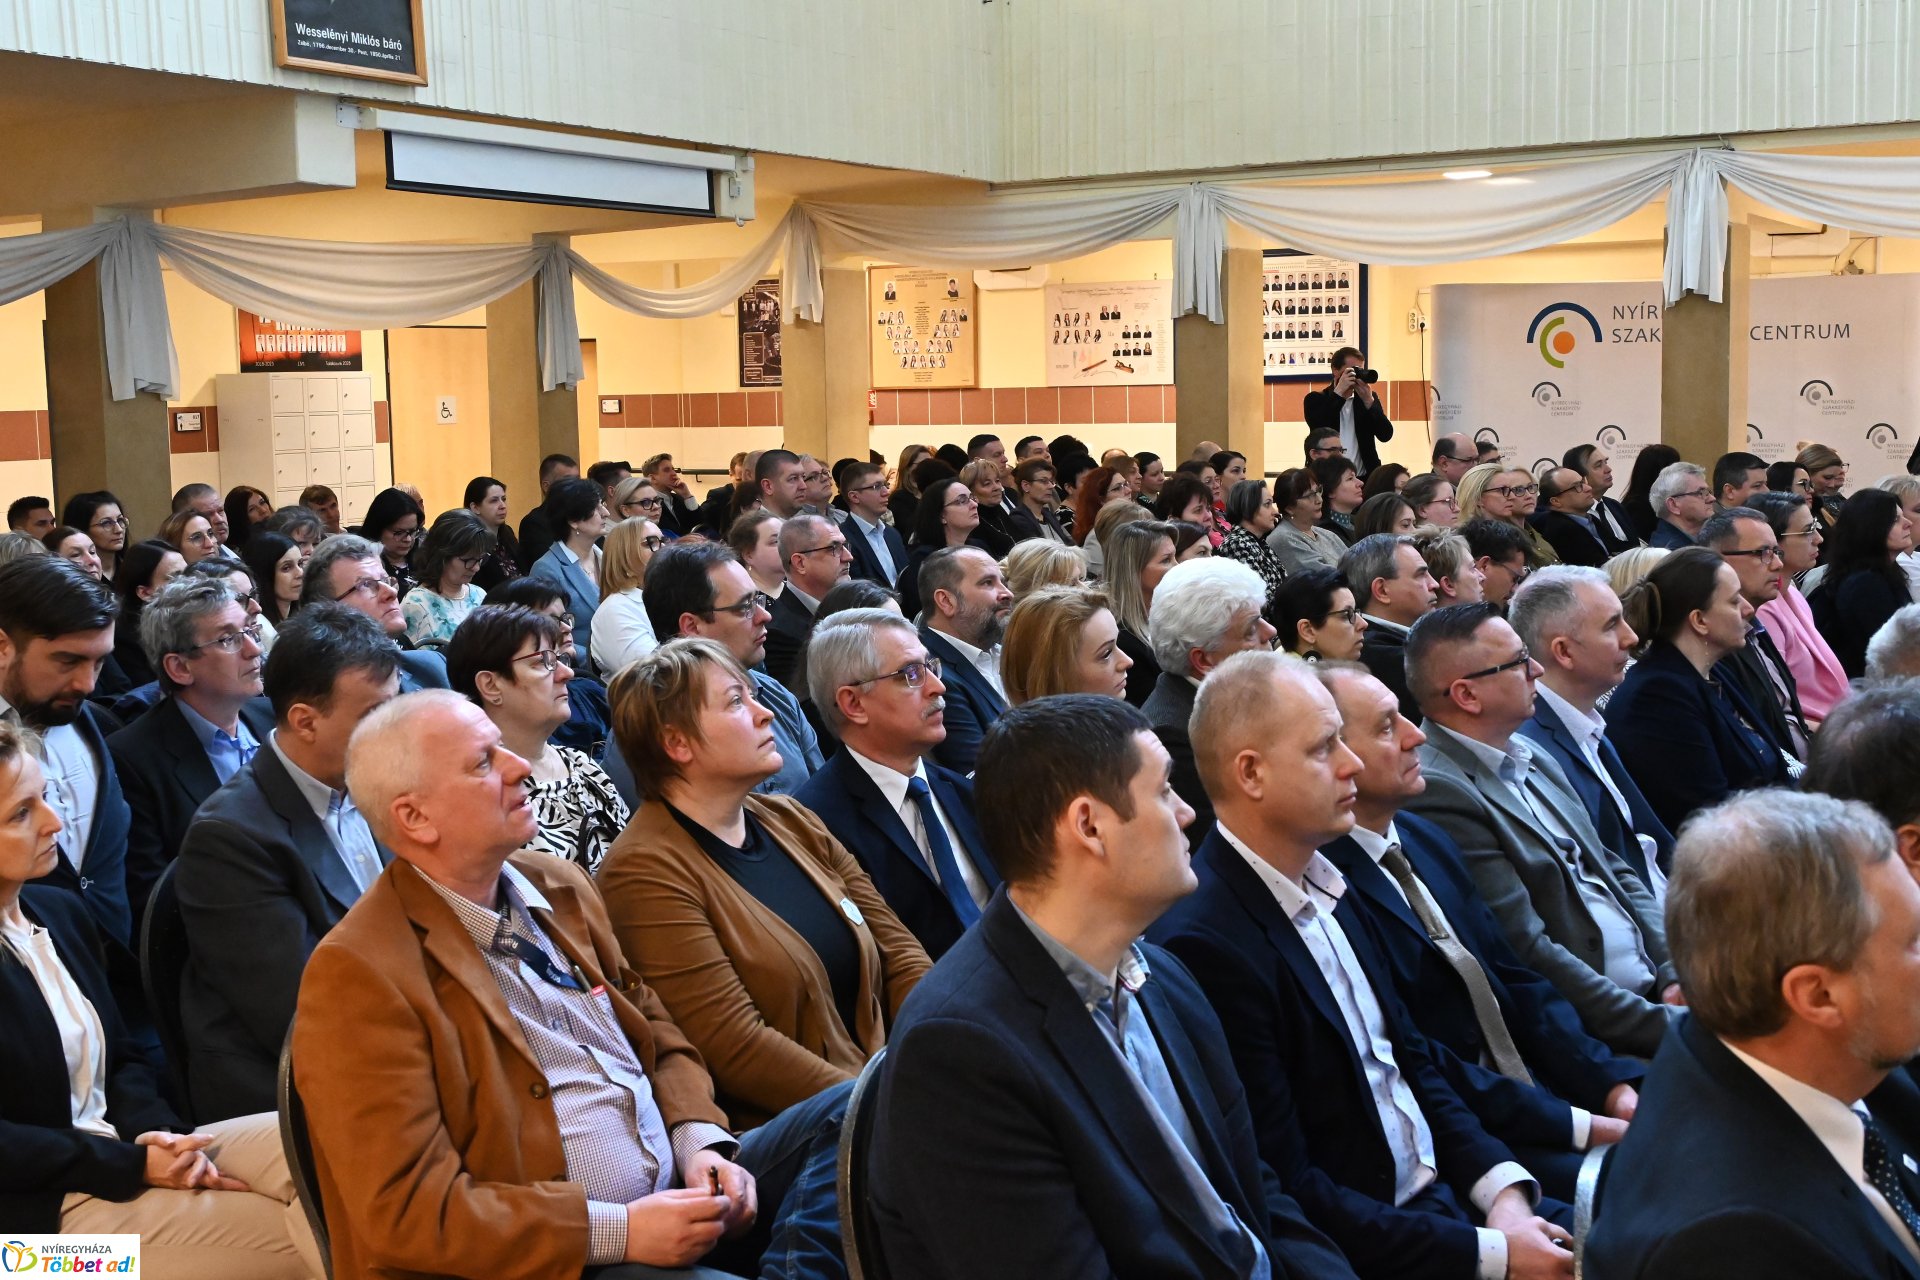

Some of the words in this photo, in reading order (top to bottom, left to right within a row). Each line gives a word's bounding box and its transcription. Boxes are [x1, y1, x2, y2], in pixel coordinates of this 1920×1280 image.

[295, 22, 349, 43] Wesselényi
[351, 31, 381, 48] Miklós
[382, 37, 403, 51] báró
[1612, 301, 1662, 320] NYÍR
[1612, 327, 1662, 343] SZAK
[1749, 323, 1851, 341] CENTRUM
